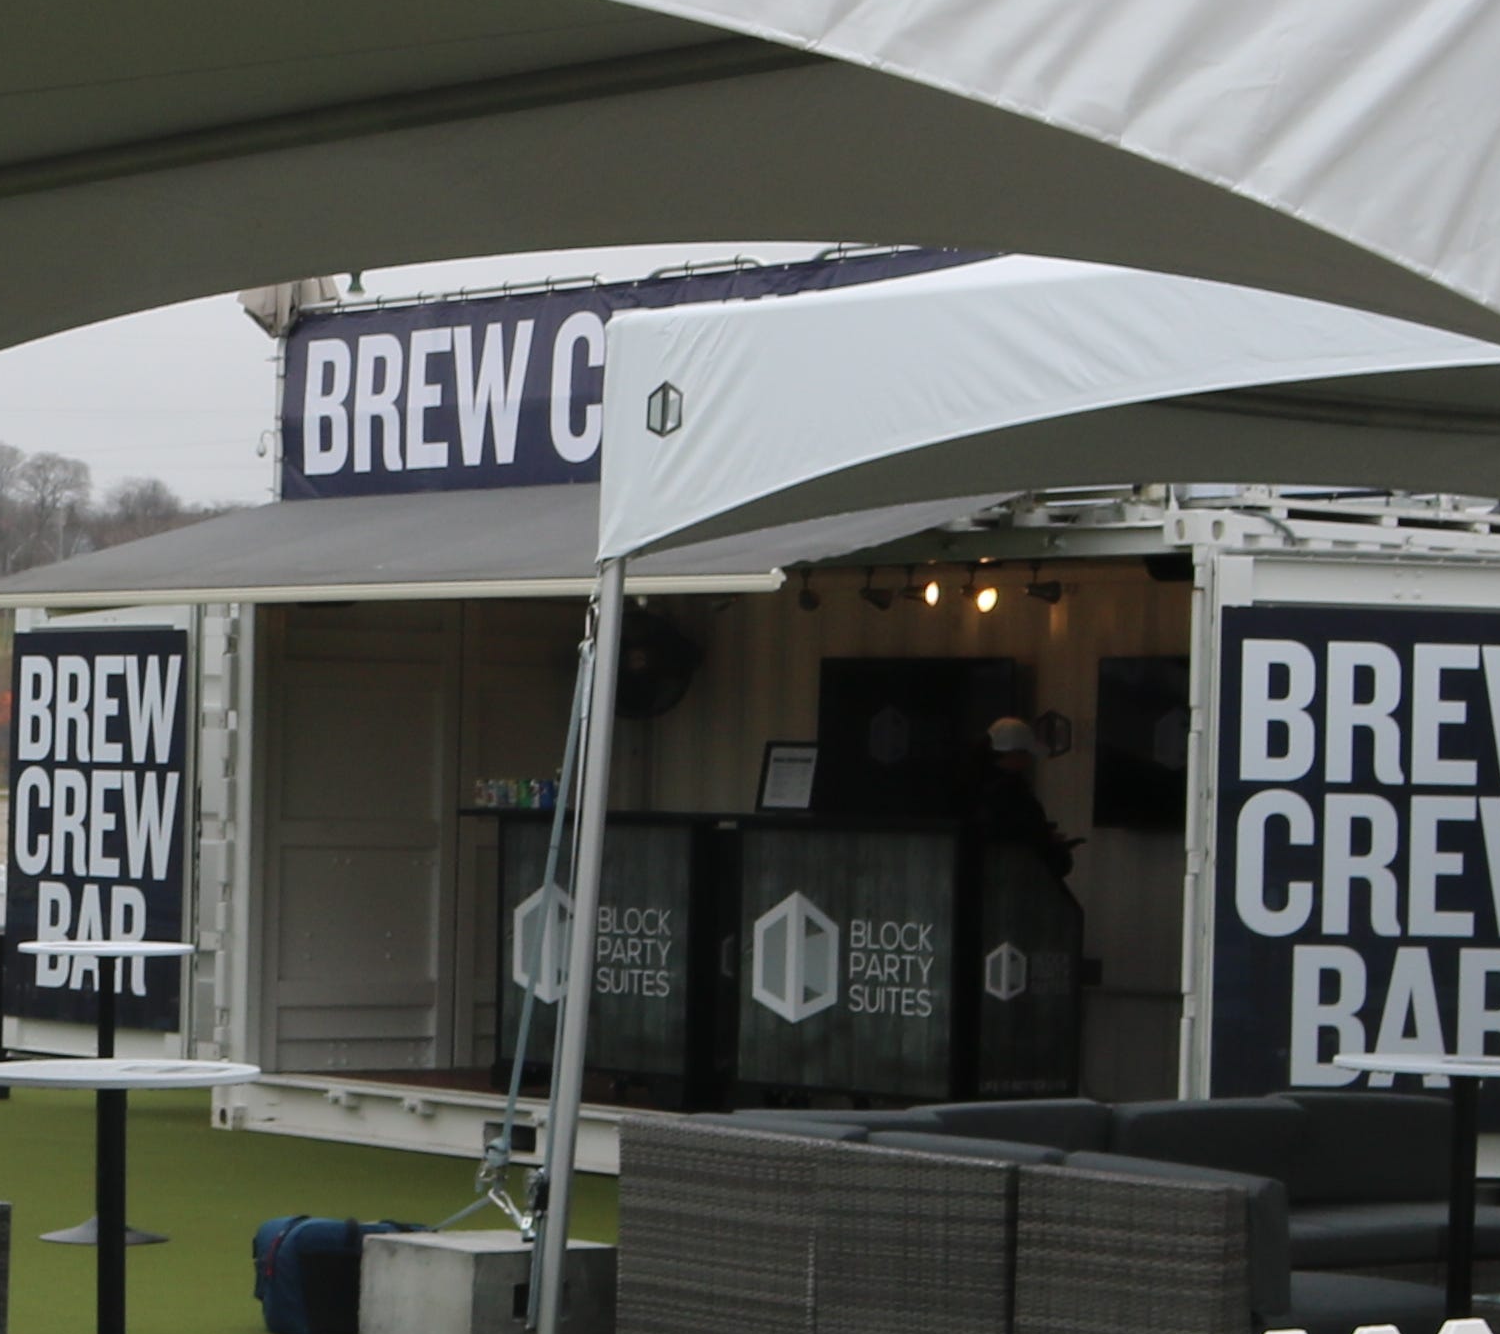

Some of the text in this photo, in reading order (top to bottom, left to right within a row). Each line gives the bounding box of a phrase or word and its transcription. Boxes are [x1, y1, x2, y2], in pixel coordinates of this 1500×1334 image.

[303, 318, 536, 476] BREW
[18, 655, 182, 764] BREW
[14, 766, 181, 881] CREW
[35, 880, 147, 997] BAR
[597, 907, 671, 937] BLOCK
[849, 919, 934, 953] BLOCK
[596, 938, 672, 967] PARTY
[848, 952, 935, 985] PARTY
[596, 969, 670, 998] SUITES
[848, 986, 933, 1018] SUITES
